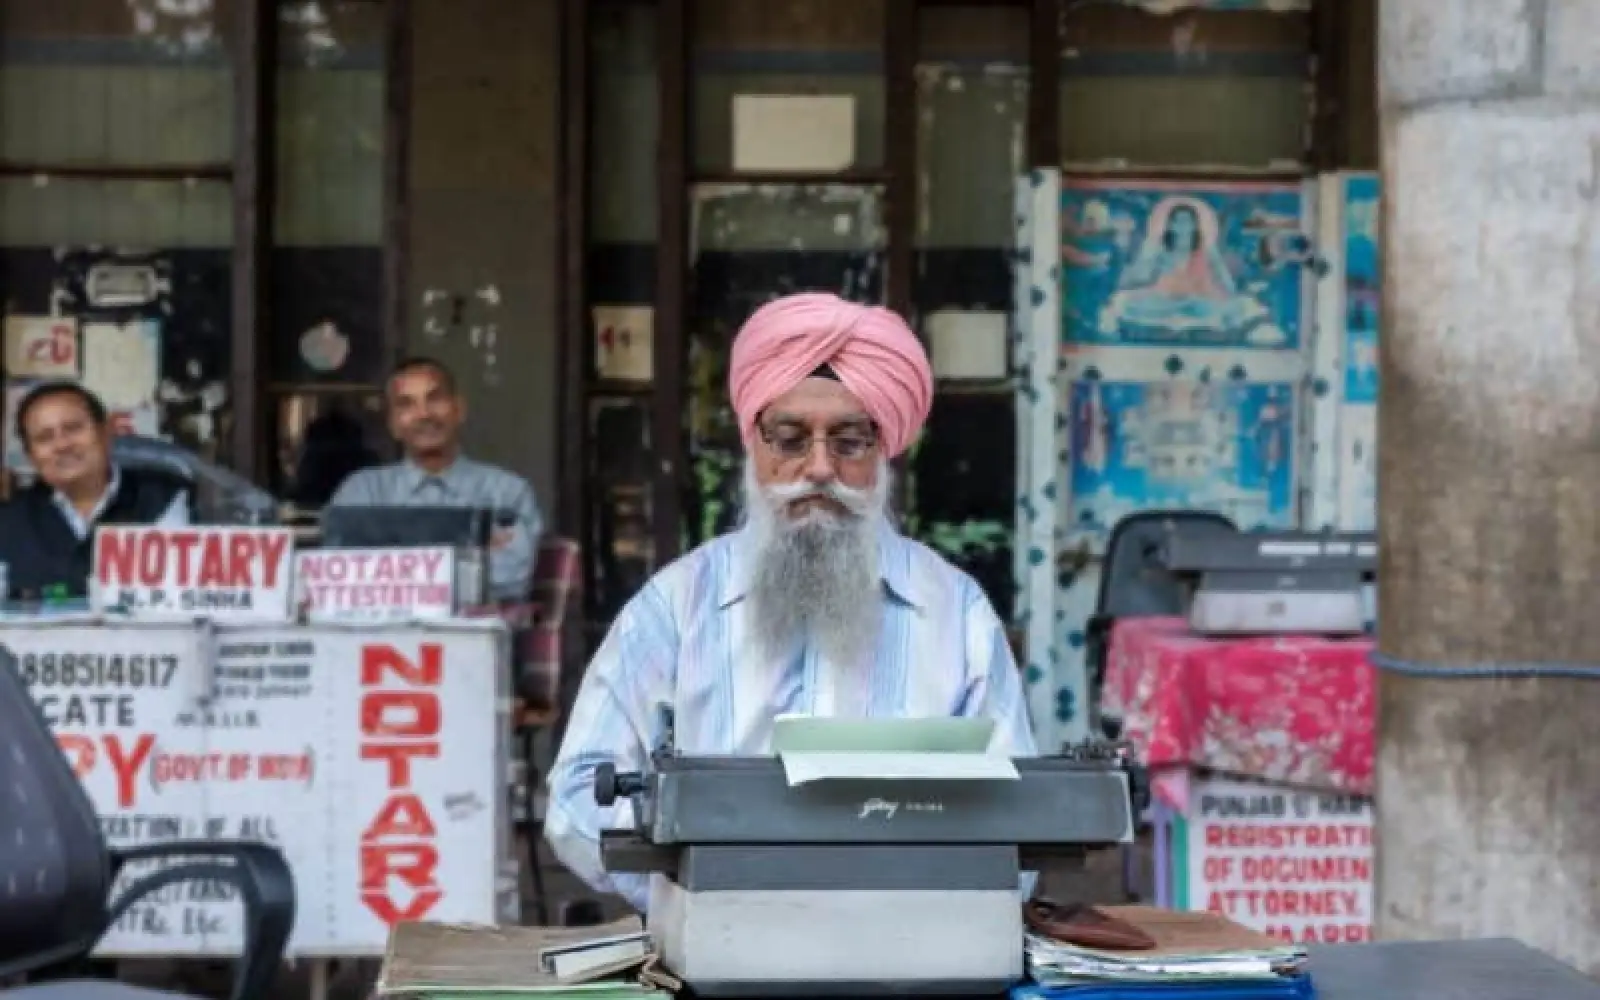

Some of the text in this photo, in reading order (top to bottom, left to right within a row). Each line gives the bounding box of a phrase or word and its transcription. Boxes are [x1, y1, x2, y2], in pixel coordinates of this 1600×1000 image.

[98, 529, 288, 588] NOTARY
[301, 551, 444, 581] NOTARY
[359, 642, 444, 927] NOTARY
[1201, 795, 1285, 817] PUNJAB
[1204, 857, 1369, 882] OF DOCUMEN
